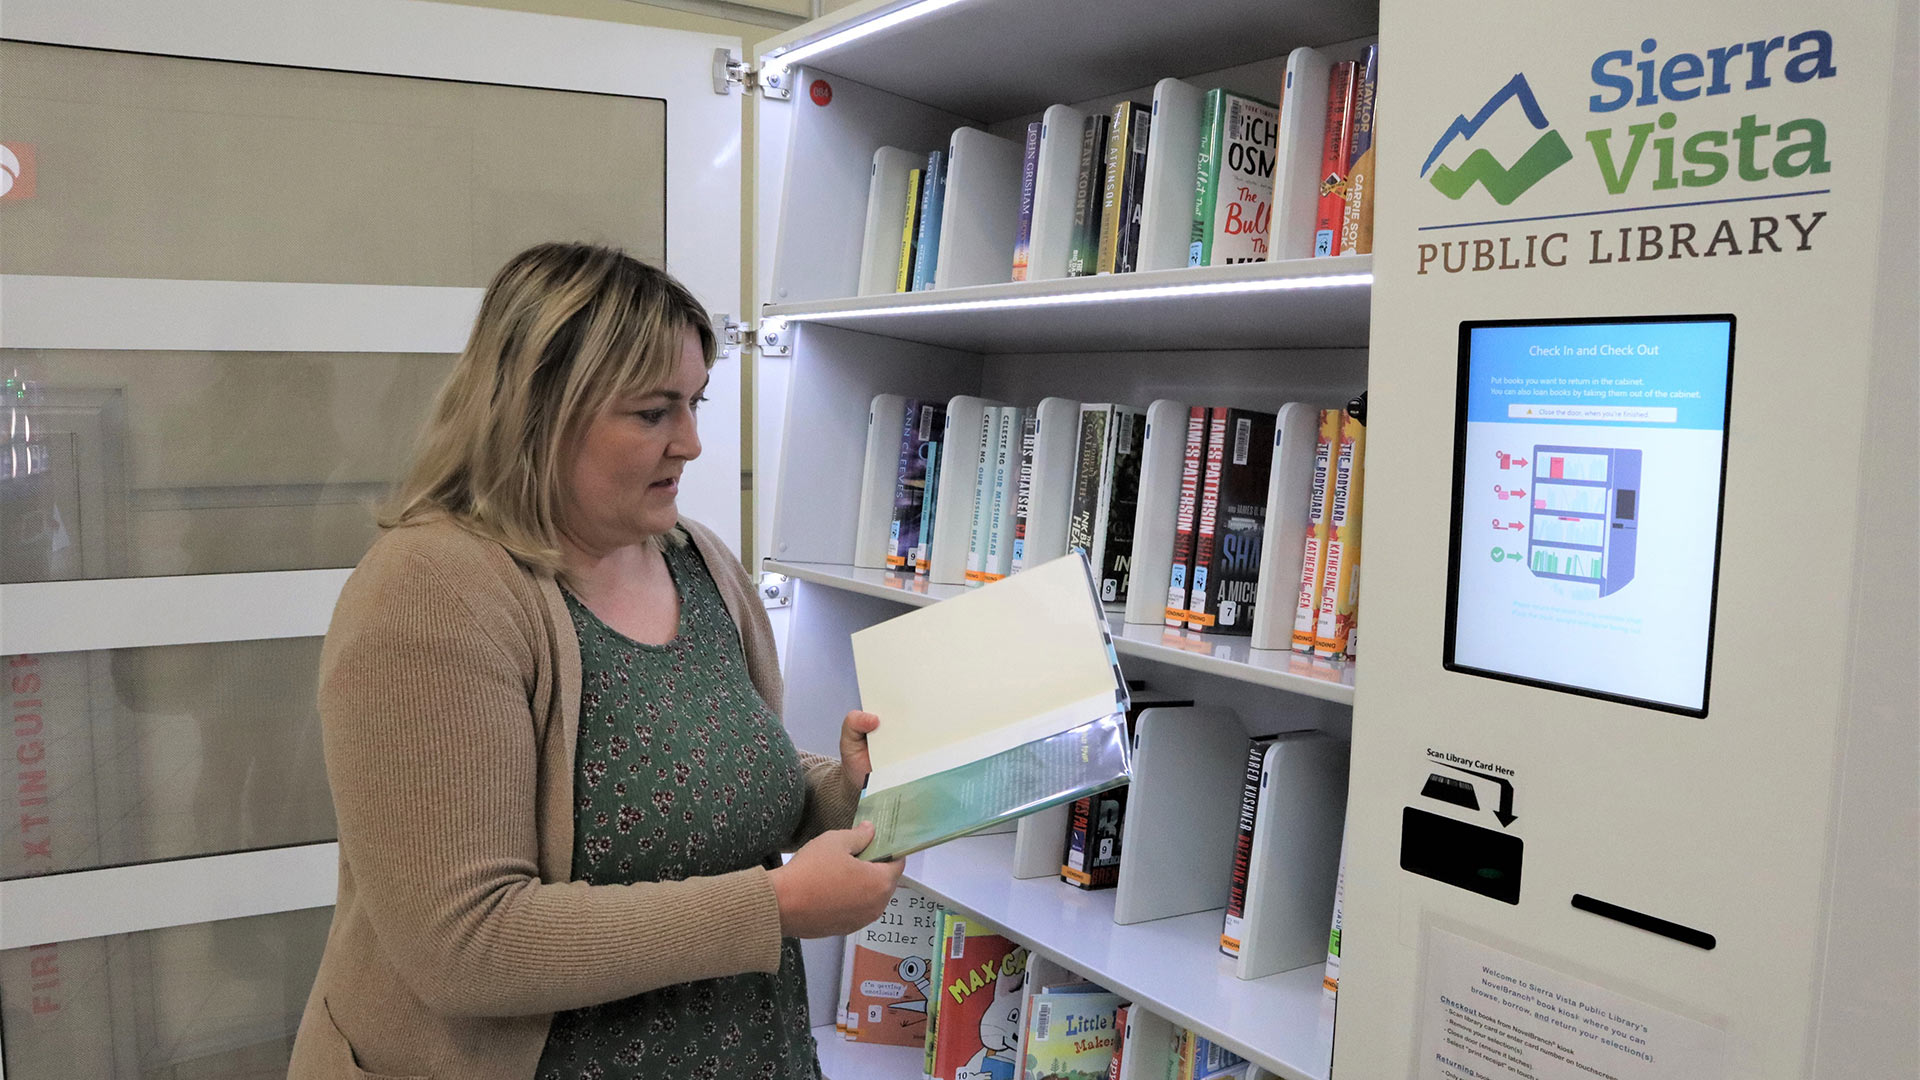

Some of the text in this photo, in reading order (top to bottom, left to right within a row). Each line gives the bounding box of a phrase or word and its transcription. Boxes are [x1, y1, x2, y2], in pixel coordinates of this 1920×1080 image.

[1589, 29, 1837, 113] Sierra
[1351, 65, 1366, 154] JENKINS REID
[1360, 81, 1374, 133] TAYLOR
[1022, 127, 1037, 215] JOHN GRISHAM
[1075, 129, 1094, 226] DEAN KOONTZ
[1104, 148, 1118, 208] ATKINSON
[1197, 152, 1209, 194] Bullet
[1585, 112, 1832, 195] Vista
[1195, 196, 1204, 216] That
[1238, 186, 1257, 203] The
[1340, 187, 1353, 248] IS BACK
[1352, 174, 1364, 220] CARRIE
[1417, 212, 1827, 275] PUBLIC LIBRARY
[1529, 344, 1659, 357] Check In and Check Out
[1491, 377, 1502, 385] Put
[1504, 377, 1524, 385] books
[1525, 378, 1537, 386] you
[1615, 378, 1644, 386] cabinet.
[1491, 388, 1503, 396] You
[1517, 388, 1531, 396] also
[1533, 388, 1548, 396] loan
[1572, 389, 1581, 398] by
[1583, 389, 1606, 398] taking
[1608, 389, 1627, 397] them
[1629, 390, 1643, 398] out
[1644, 389, 1653, 397] of
[1655, 390, 1668, 398] the
[1670, 390, 1701, 398] cabinet.
[896, 408, 913, 498] ANN CLEEVES
[972, 414, 989, 526] CELESTE NG OUR MISSING
[1023, 434, 1035, 457] IRIS
[1079, 424, 1094, 501] GALBRAITH
[992, 415, 1009, 529] CELESTE NG OUR MISSING
[1016, 460, 1032, 518] JOHANSEN
[1177, 418, 1203, 531] JAMES PATTERSON
[1199, 418, 1225, 535] JAMES PATTERSON
[1310, 444, 1328, 520] THE BODYGUARD
[1333, 444, 1352, 522] THE BODYGUARD
[1081, 510, 1090, 532] INK
[1237, 505, 1253, 515] JAMES
[1106, 586, 1112, 594] 9
[1217, 579, 1226, 601] A
[1302, 541, 1317, 592] KATHERINE
[1326, 544, 1340, 595] KATHERINE
[1227, 608, 1232, 616] 7
[1426, 748, 1515, 777] Scan Library Card Here
[1240, 748, 1262, 832] JARED KUSHNER
[1102, 846, 1107, 854] 9
[1232, 834, 1250, 884] BREAKING
[867, 930, 918, 945] Roller
[948, 960, 997, 1004] MAX
[1482, 966, 1648, 1033] Welcome to Sierra Vista Public Library's
[1066, 1014, 1107, 1036] Little
[1440, 995, 1575, 1055] Checkout books from kiosk
[1447, 1028, 1463, 1040] Close
[1464, 1035, 1478, 1045] door
[1478, 1041, 1502, 1054] (ensure
[1448, 1008, 1575, 1065] Scan library card or enter card number on
[1449, 1018, 1487, 1041] Remove your
[1470, 986, 1500, 1002] browse,
[1534, 1010, 1549, 1023] and
[1551, 1018, 1577, 1033] return
[1579, 1029, 1599, 1042] your
[1600, 1037, 1655, 1063] selection(s).
[1536, 999, 1646, 1046] book kiosk where you can
[958, 1072, 967, 1080] 10
[1436, 1053, 1474, 1077] Returning
[1446, 1037, 1465, 1050] Select
[1508, 1064, 1516, 1072] on
